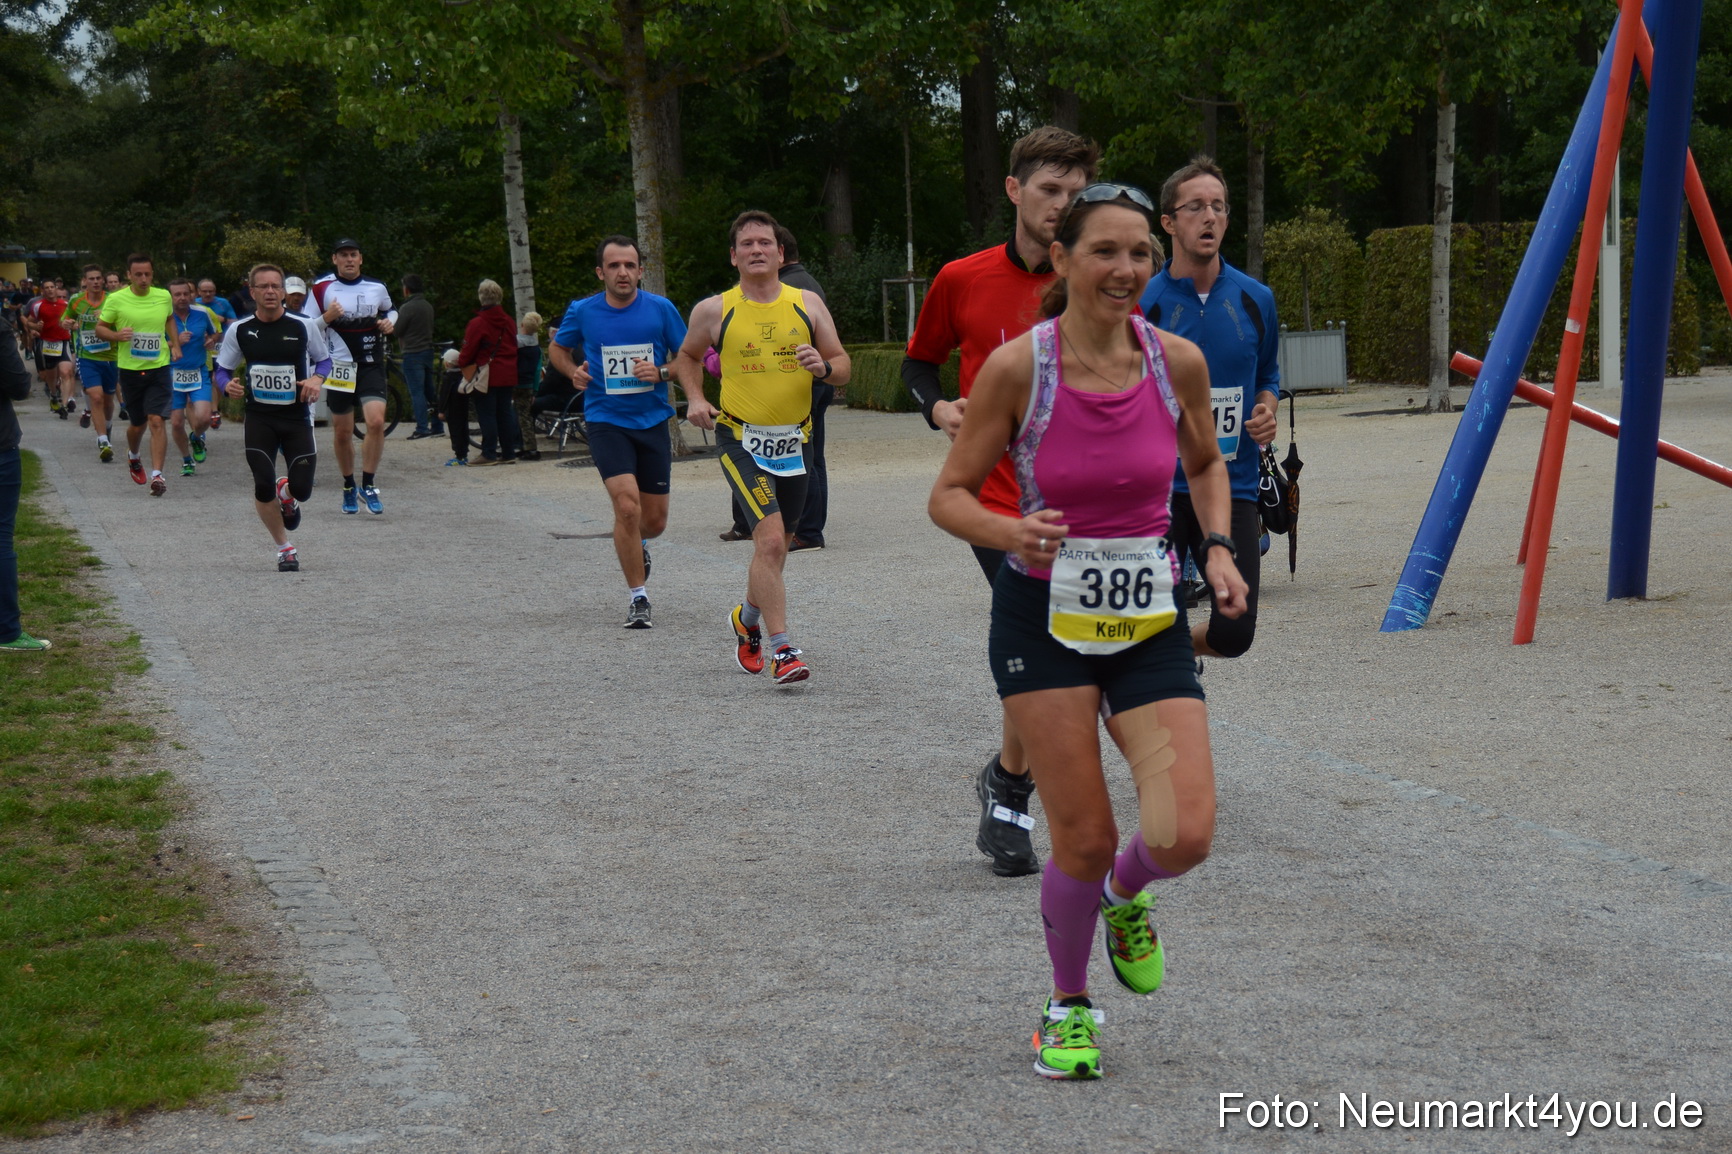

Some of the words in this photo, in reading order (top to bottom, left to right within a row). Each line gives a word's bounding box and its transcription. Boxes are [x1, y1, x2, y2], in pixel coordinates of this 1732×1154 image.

[133, 338, 160, 350] 2780
[608, 356, 648, 376] 21
[256, 374, 292, 390] 2063
[262, 392, 286, 400] Michael
[1212, 406, 1236, 434] 15
[749, 437, 800, 459] 2682
[1058, 549, 1099, 561] PARTL
[1102, 550, 1155, 561] Neumarkt
[1079, 567, 1154, 611] 386
[1096, 621, 1136, 640] Kelly
